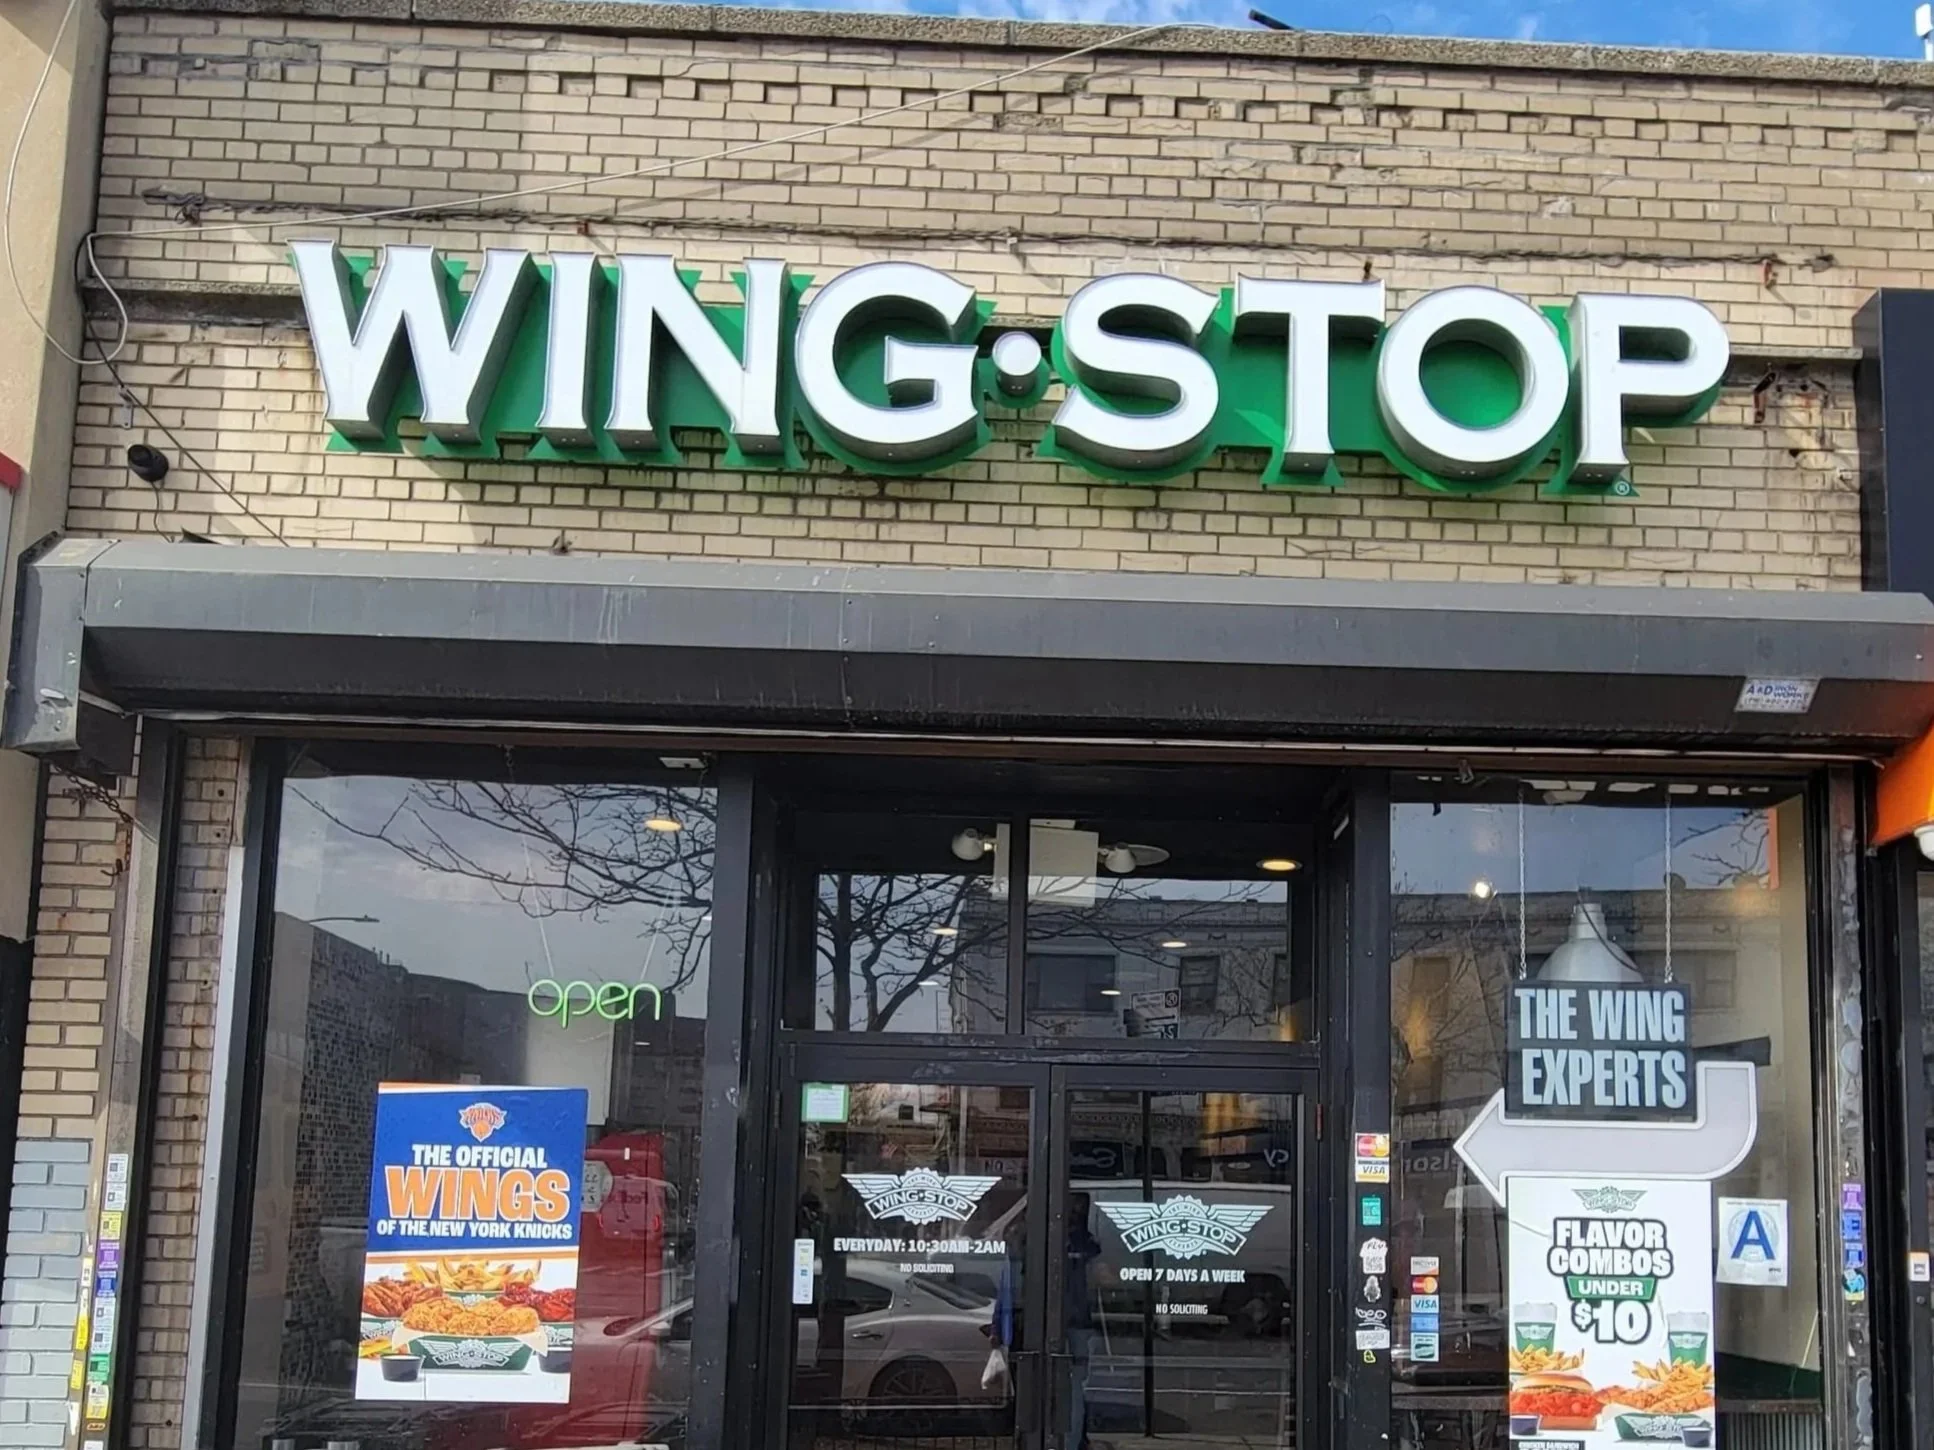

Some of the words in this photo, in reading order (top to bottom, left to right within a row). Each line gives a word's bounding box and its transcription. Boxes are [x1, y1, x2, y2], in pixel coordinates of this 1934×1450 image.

[528, 979, 661, 1029] open
[1515, 988, 1577, 1040] THE
[1588, 990, 1685, 1042] WING
[1522, 1048, 1686, 1109] EXPERTS
[412, 1144, 450, 1166] THE
[455, 1145, 548, 1168] OFFICIAL
[1362, 1166, 1386, 1174] VISA
[385, 1166, 570, 1223] WINGS
[376, 1220, 398, 1236] OF
[398, 1220, 428, 1237] THE
[429, 1221, 465, 1237] NEW
[469, 1222, 510, 1238] YORK
[514, 1223, 573, 1239] KNICKS
[1556, 1219, 1665, 1248] FLAVOR
[1731, 1210, 1776, 1260] A
[834, 1238, 906, 1253] EVERYDAY:
[908, 1239, 1006, 1254] 10:30AM-2AM
[900, 1263, 912, 1273] NO
[913, 1263, 955, 1274] SOLICITING
[1549, 1247, 1672, 1277] COMBOS
[1120, 1268, 1151, 1281] OPEN
[1154, 1268, 1164, 1281] 7
[1167, 1268, 1198, 1282] DAYS
[1200, 1269, 1210, 1282] A
[1212, 1270, 1245, 1283] WEEK
[1578, 1280, 1643, 1296] UNDER
[1156, 1304, 1168, 1314] NO
[1169, 1304, 1208, 1315] SOLICITING
[1414, 1300, 1437, 1308] VISA
[1573, 1299, 1649, 1342] $10
